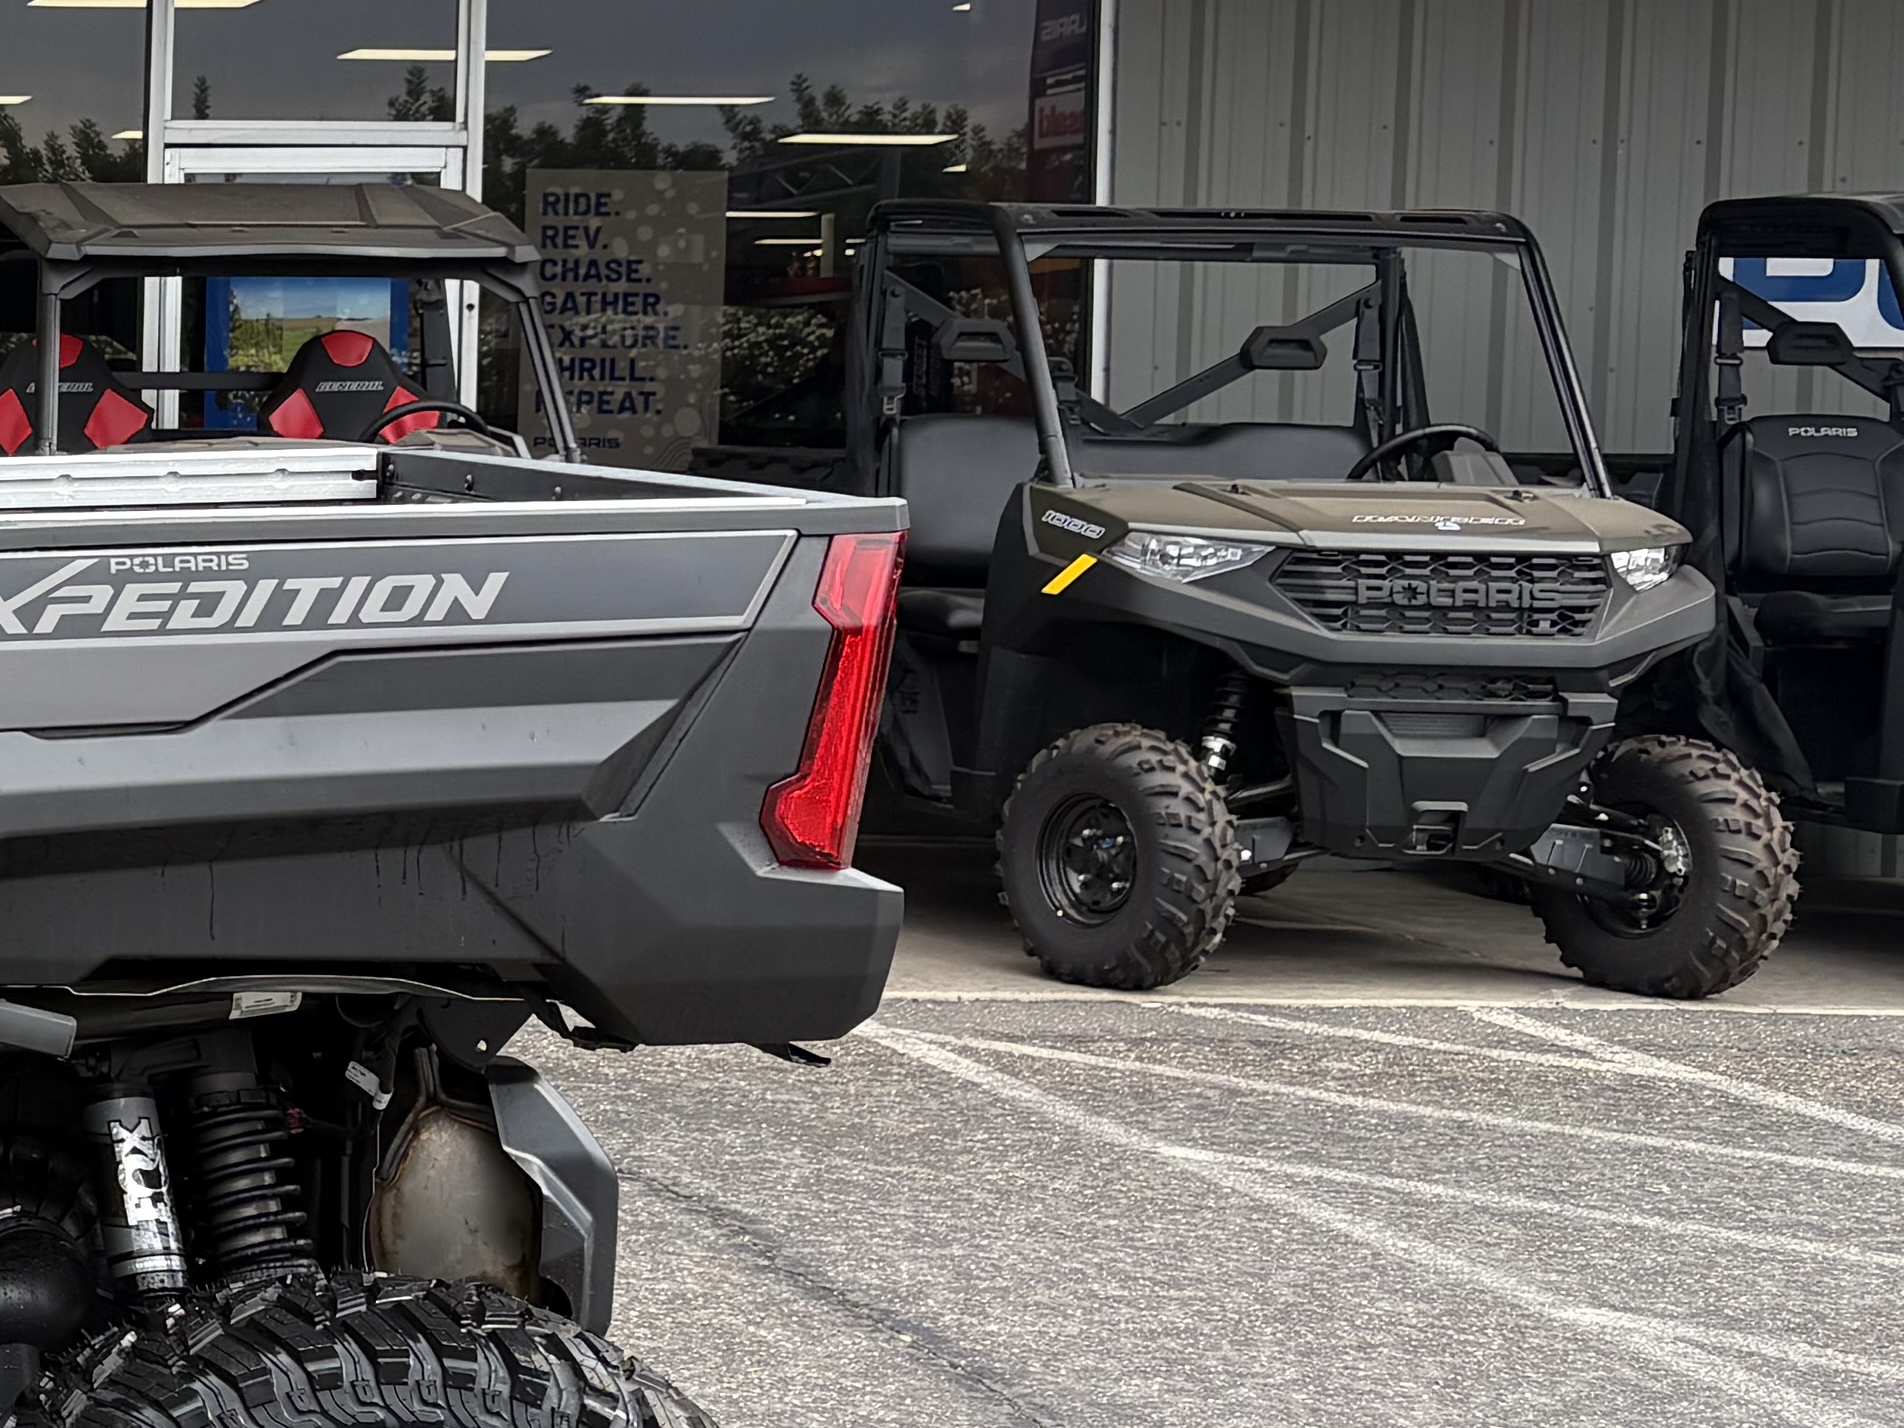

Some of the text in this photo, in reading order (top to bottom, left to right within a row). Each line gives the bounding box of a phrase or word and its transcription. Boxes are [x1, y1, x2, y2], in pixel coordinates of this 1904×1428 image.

[542, 192, 620, 216] RIDE.
[541, 226, 608, 249] REV.
[539, 259, 652, 283] CHASE.
[539, 292, 669, 316] GATHER.
[558, 358, 655, 382] HRILL.
[535, 391, 662, 415] PEAT.
[1789, 427, 1858, 437] POLARIS
[1041, 510, 1104, 539] 1000
[110, 553, 250, 574] POLARIS
[1357, 579, 1563, 609] POLARIS
